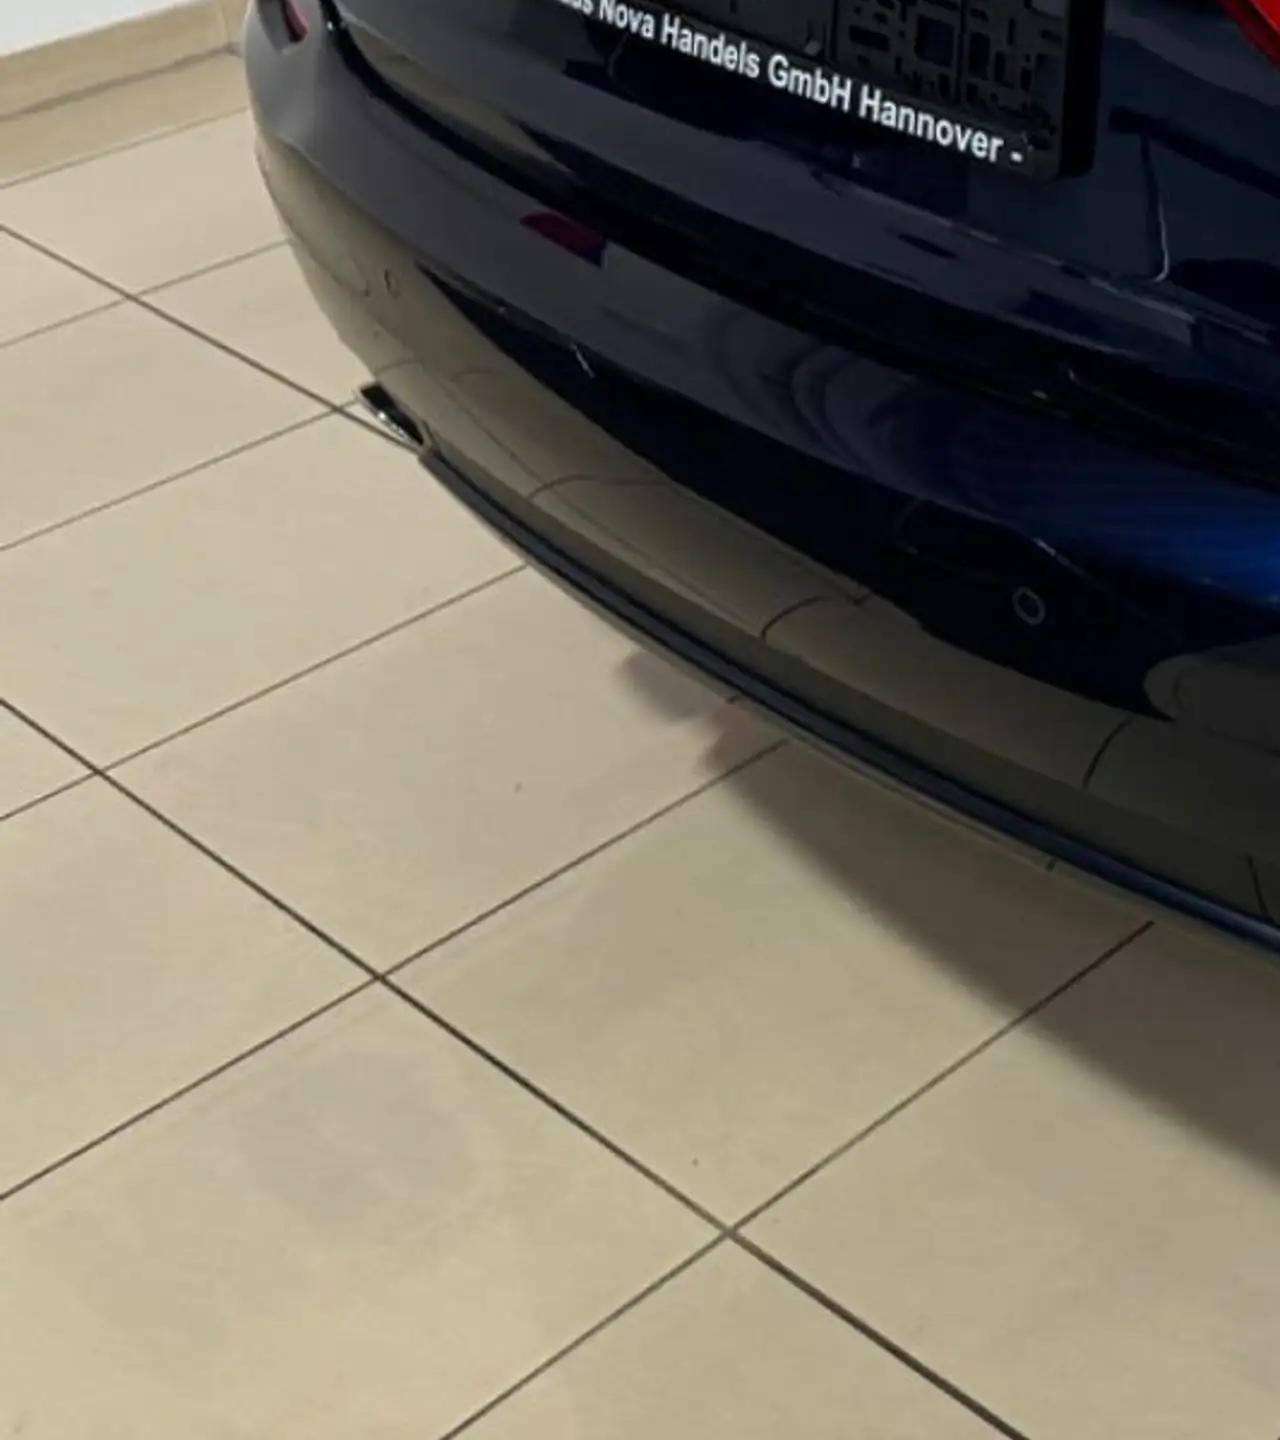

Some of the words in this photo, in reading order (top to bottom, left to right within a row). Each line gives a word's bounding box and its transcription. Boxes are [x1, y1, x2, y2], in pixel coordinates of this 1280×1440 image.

[661, 11, 760, 79] Handels
[767, 54, 852, 113] GmbH
[858, 83, 1005, 163] Hannover
